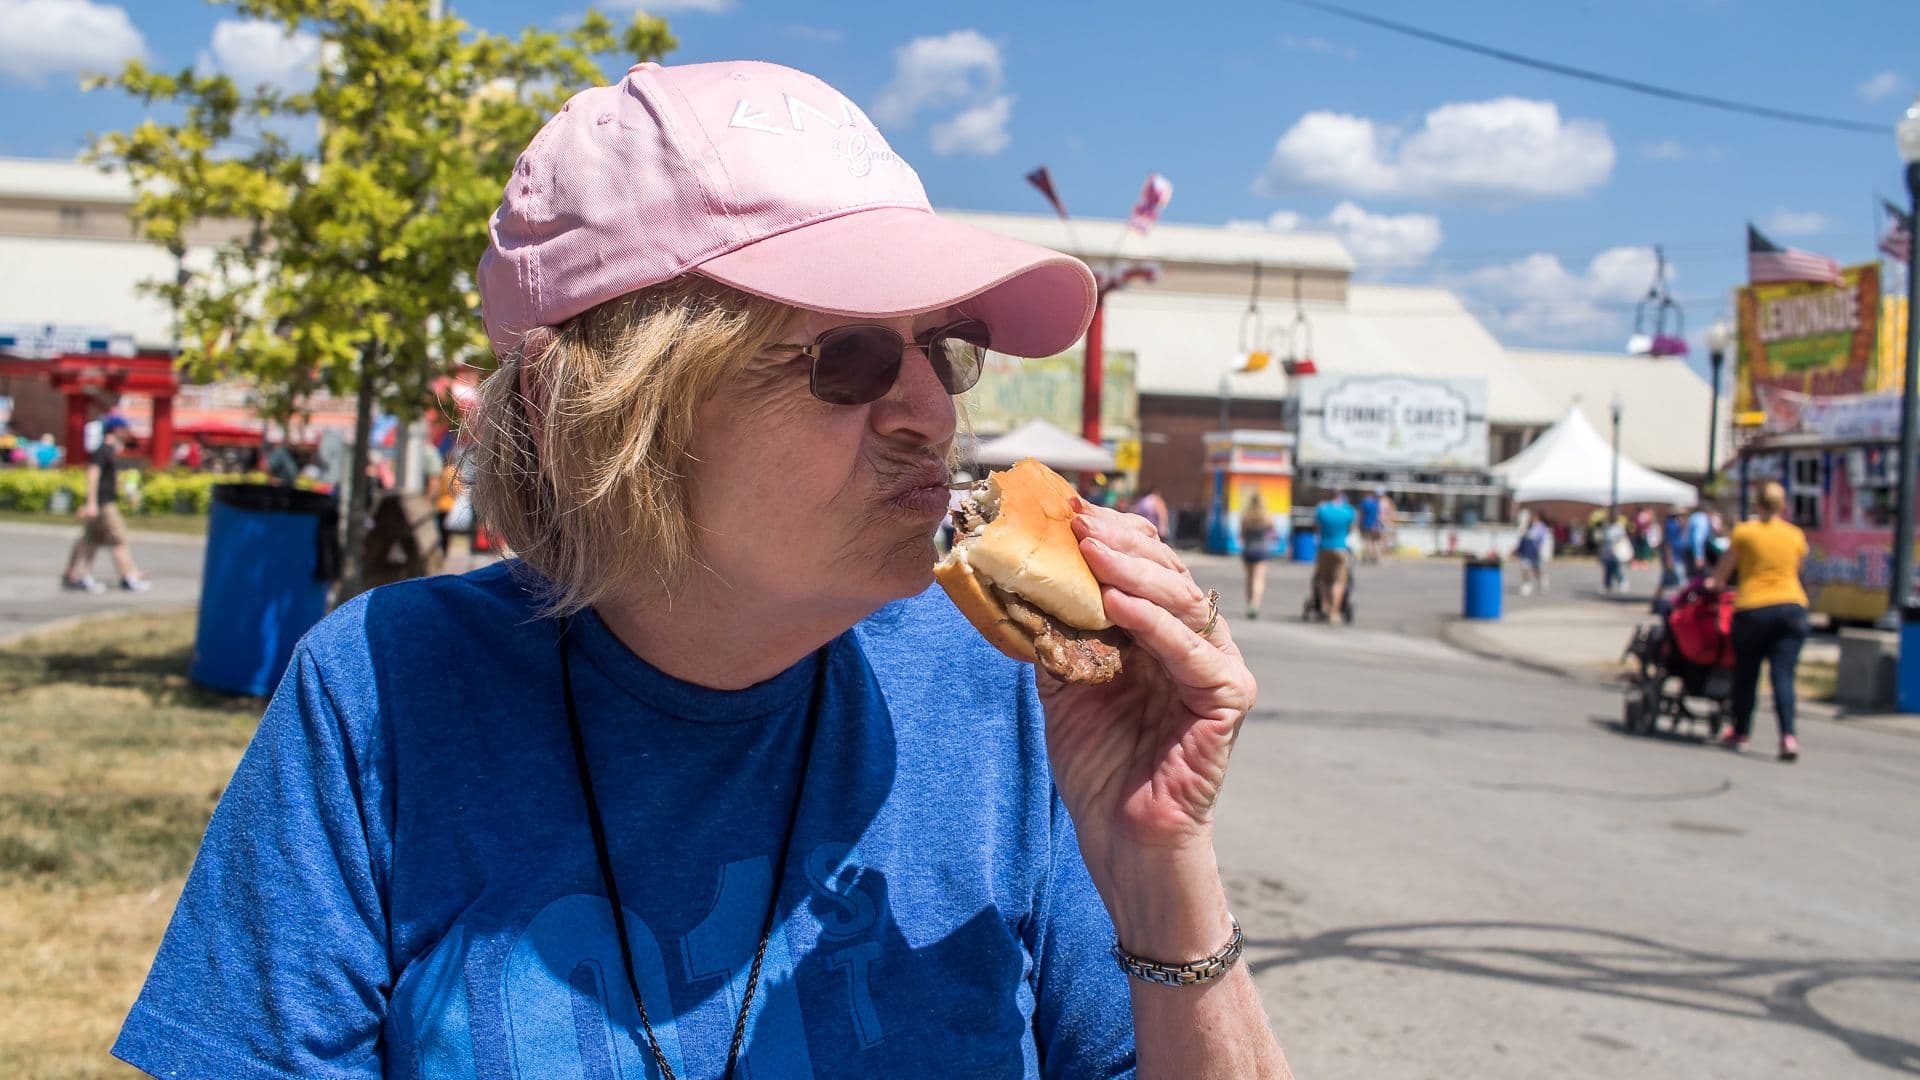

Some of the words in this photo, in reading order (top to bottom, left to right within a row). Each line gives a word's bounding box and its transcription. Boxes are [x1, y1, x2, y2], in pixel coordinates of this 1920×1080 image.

[1757, 286, 1860, 341] LEMONADE
[1331, 403, 1397, 425] FUNNEL
[1404, 406, 1457, 427] CAKES
